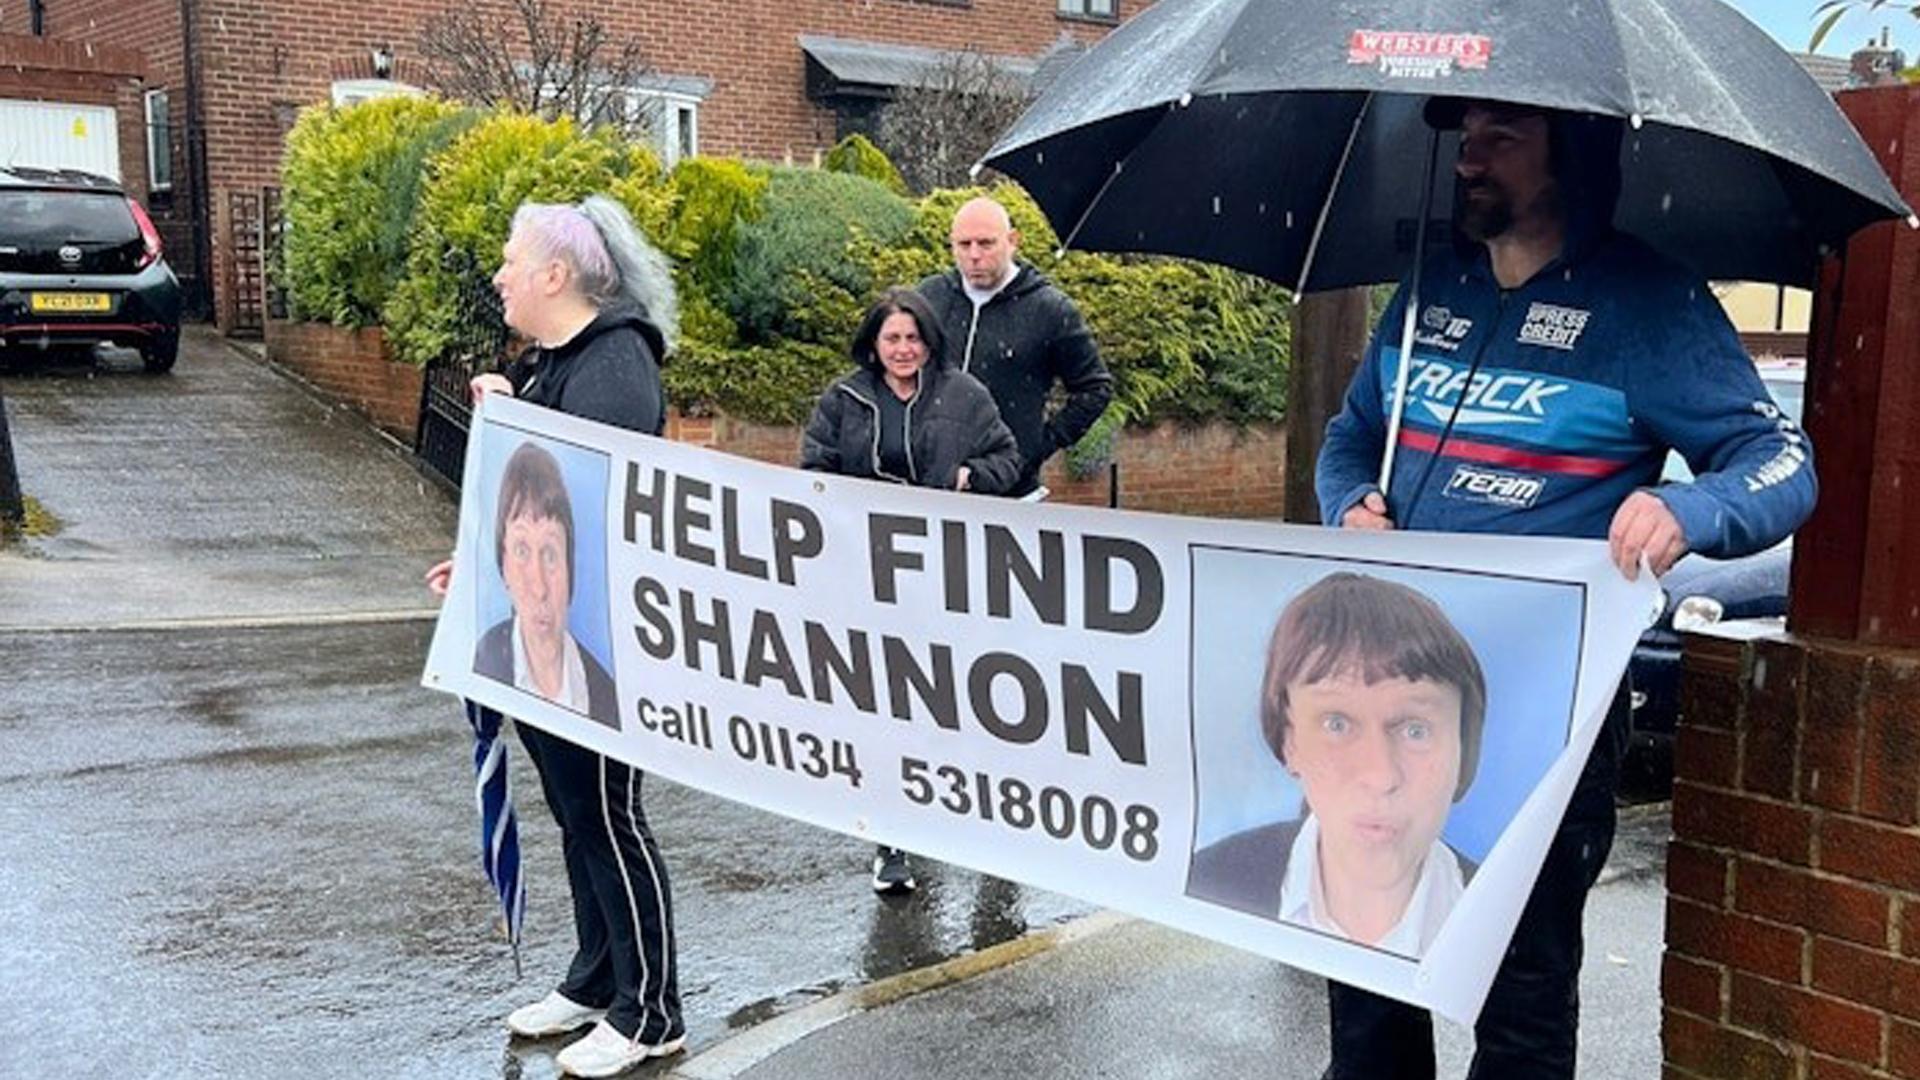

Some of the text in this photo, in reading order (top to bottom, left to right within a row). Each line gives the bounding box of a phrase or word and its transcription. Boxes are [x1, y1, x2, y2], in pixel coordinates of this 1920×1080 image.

[1520, 322, 1580, 346] CREDIT
[622, 460, 1165, 635] HELP FIND
[1453, 469, 1538, 498] TEAM
[633, 575, 1148, 767] SHANNON
[637, 696, 713, 750] call
[901, 756, 1160, 863] 5318008
